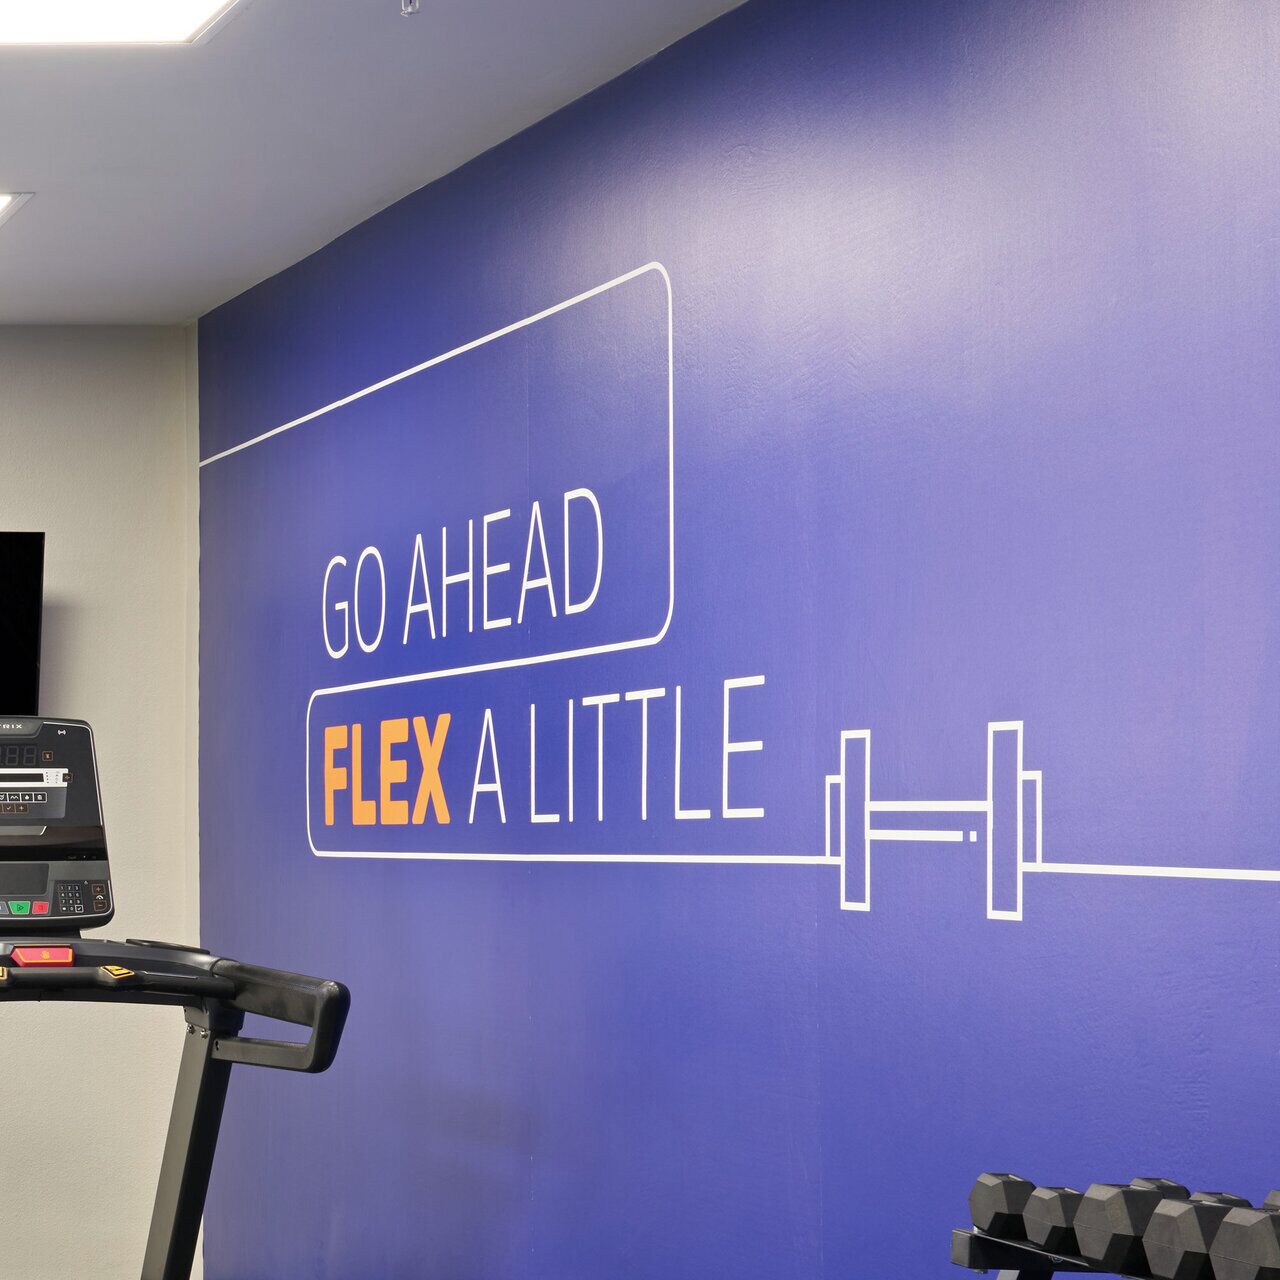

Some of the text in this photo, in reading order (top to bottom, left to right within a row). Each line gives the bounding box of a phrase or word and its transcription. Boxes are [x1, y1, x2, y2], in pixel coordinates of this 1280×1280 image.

[322, 487, 605, 659] GO AHEAD
[323, 674, 767, 826] FLEX A LITTLE
